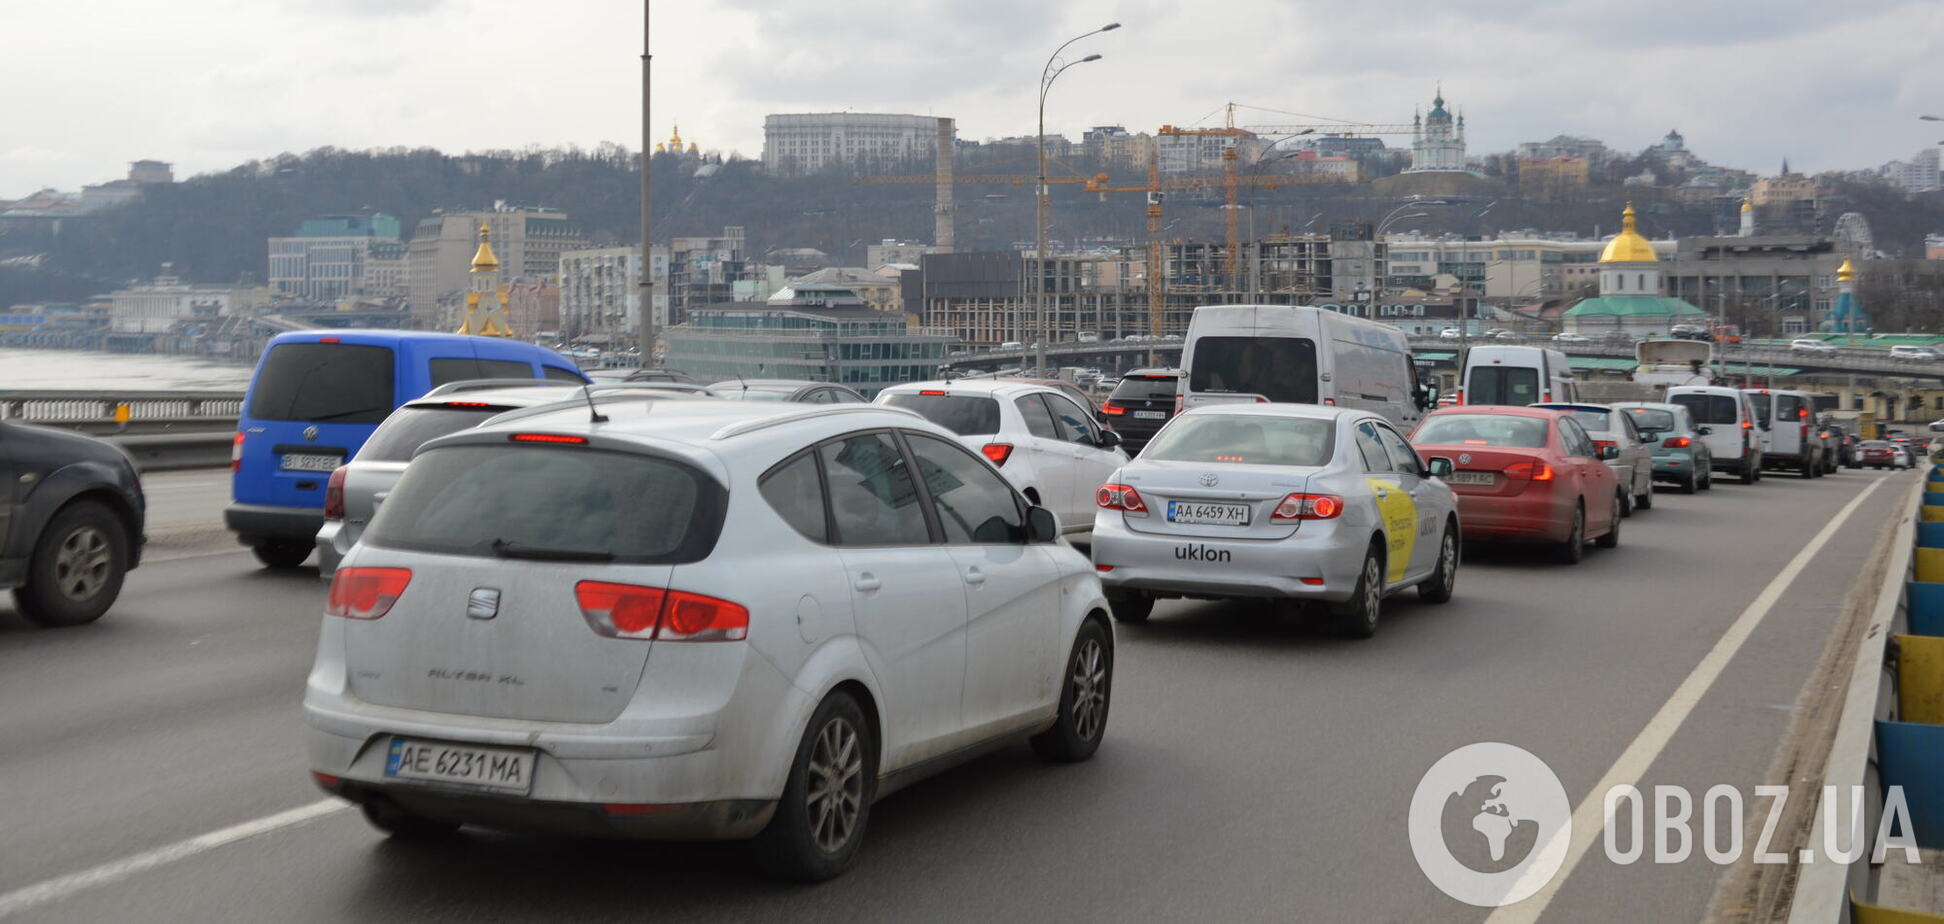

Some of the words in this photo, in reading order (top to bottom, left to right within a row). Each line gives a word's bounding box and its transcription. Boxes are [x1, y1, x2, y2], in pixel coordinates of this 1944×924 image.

[1176, 505, 1193, 517] AA
[1196, 506, 1223, 519] 6459
[1227, 507, 1244, 520] XH
[1175, 543, 1231, 563] uklon
[398, 747, 432, 773] AE
[435, 750, 486, 779] 6231
[488, 756, 521, 783] MA
